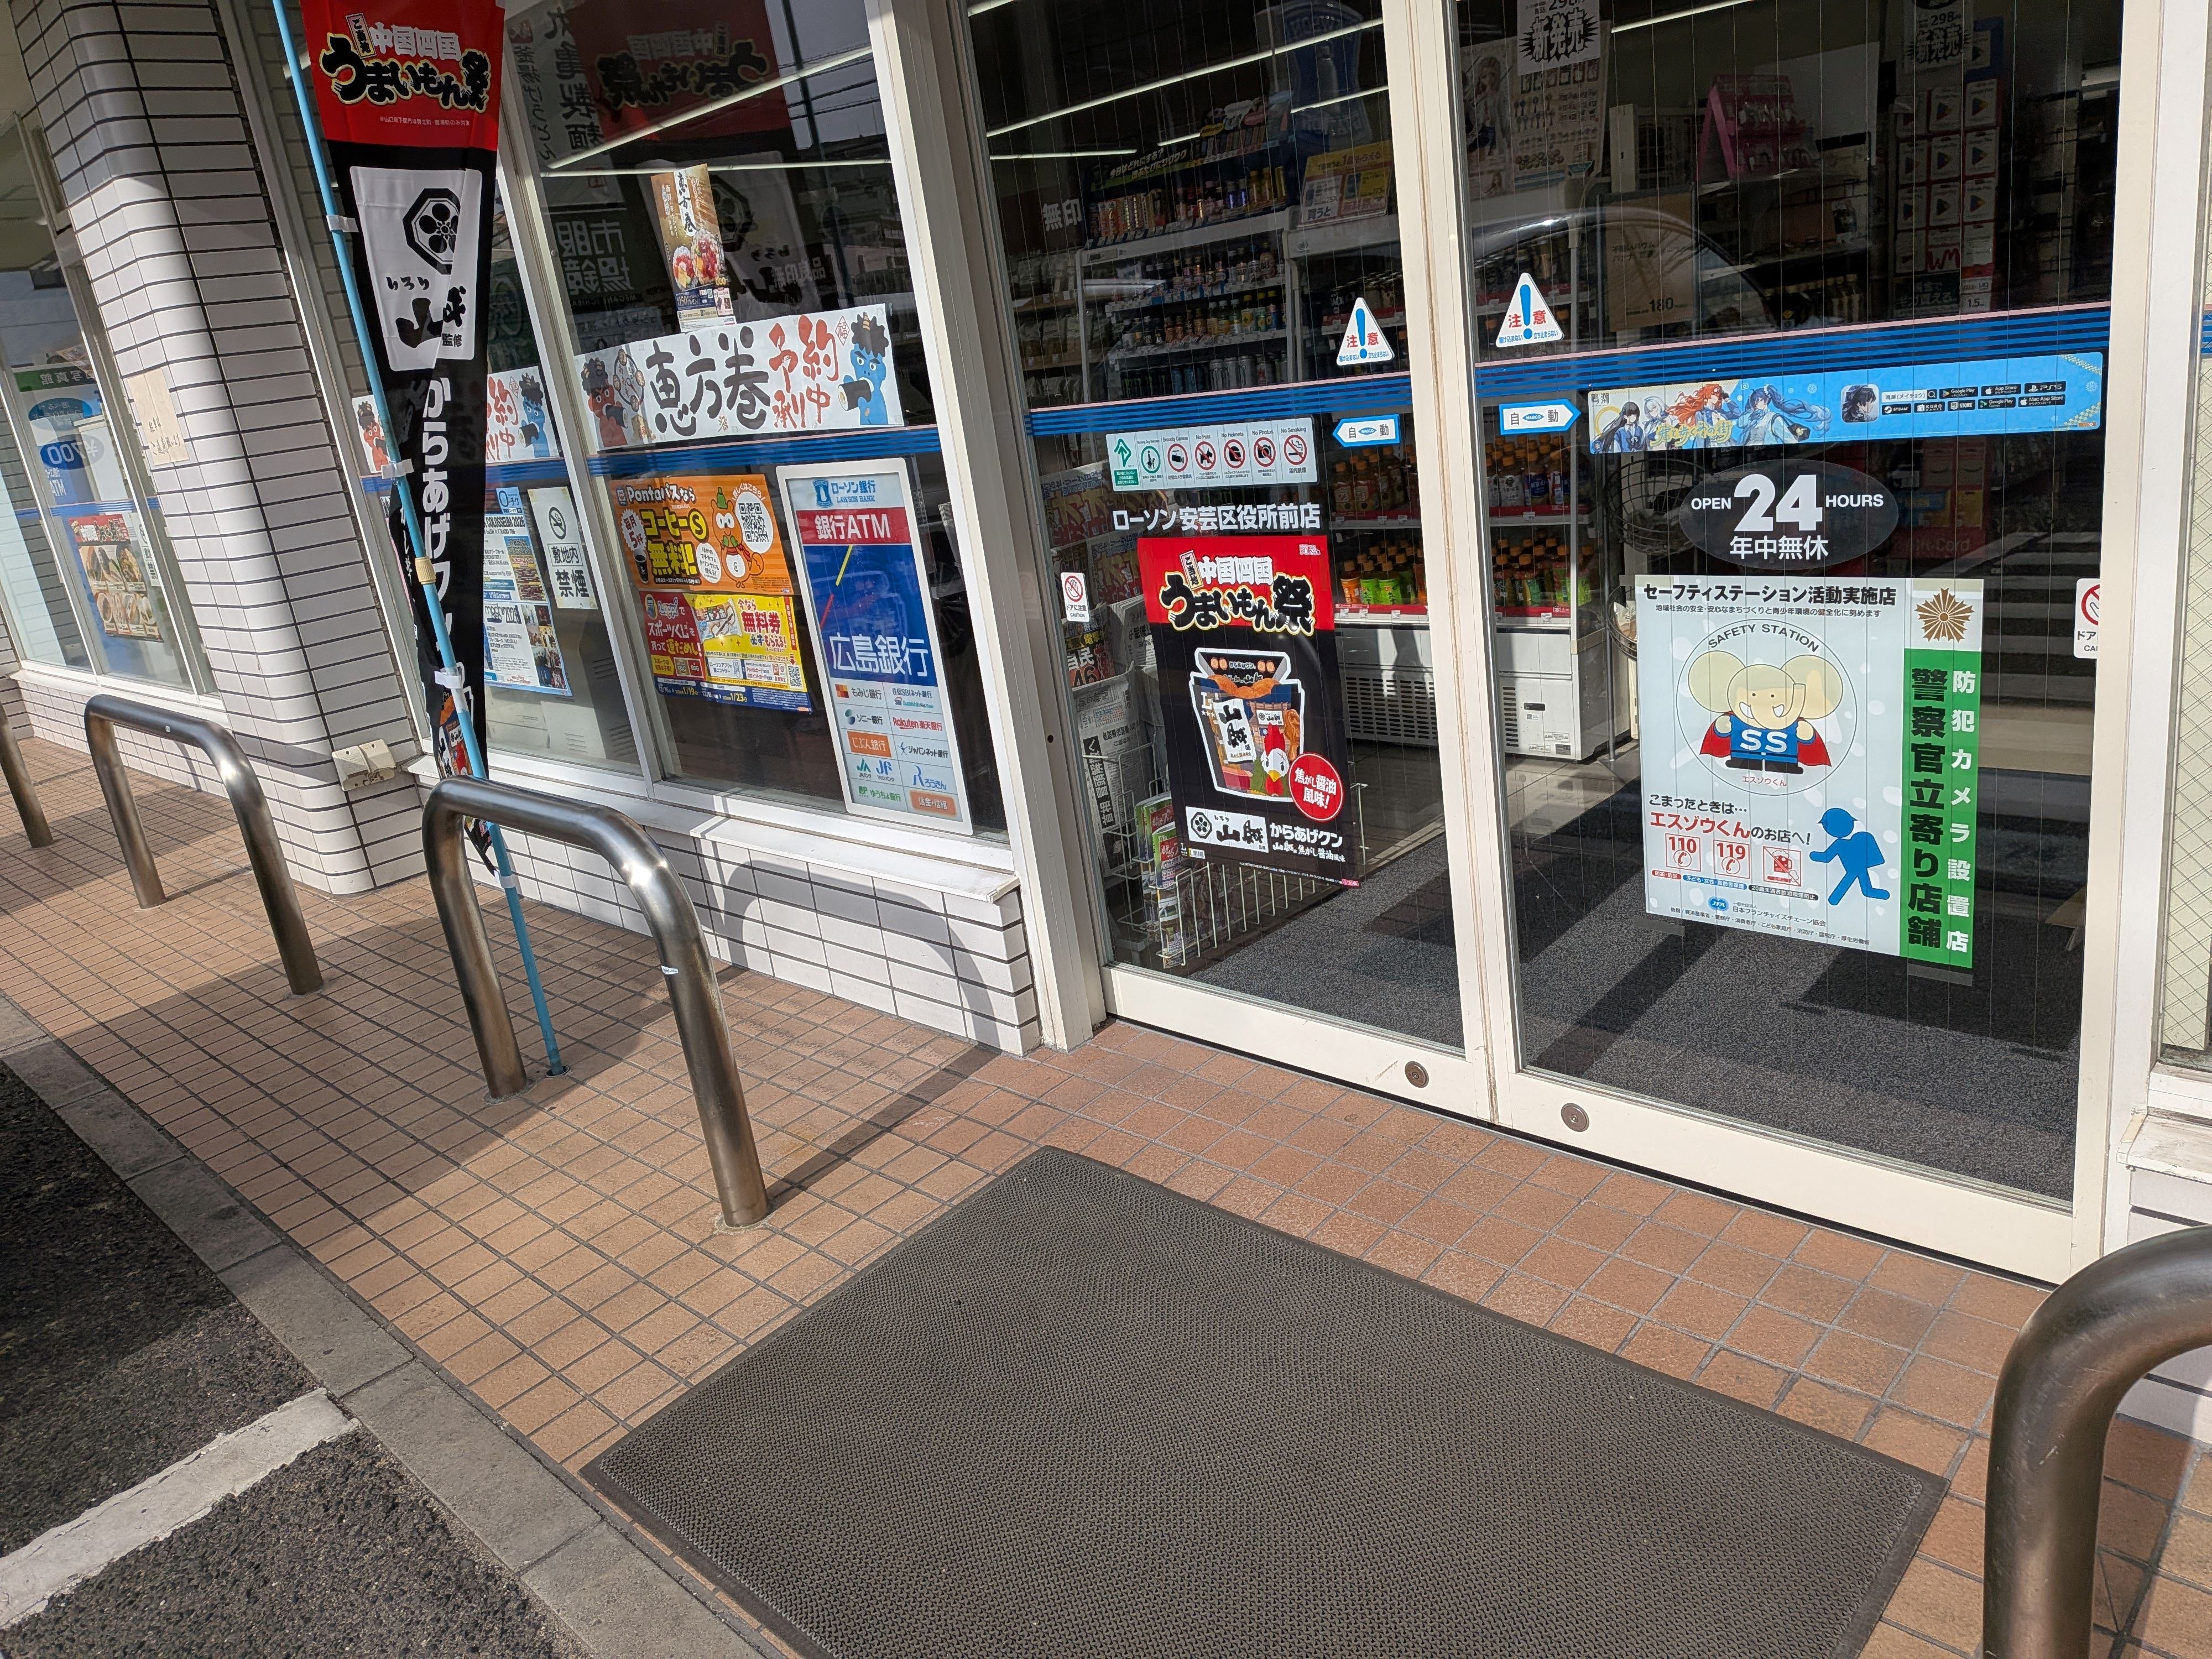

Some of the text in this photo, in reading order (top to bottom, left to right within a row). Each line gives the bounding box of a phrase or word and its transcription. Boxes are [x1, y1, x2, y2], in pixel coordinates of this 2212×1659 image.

[369, 22, 461, 60] 中国四国
[1531, 7, 1585, 62] 新発売
[768, 315, 839, 392] 予約
[831, 479, 876, 494] ローソン銀行
[836, 494, 876, 504] LAWSON BANK
[1691, 473, 1884, 531] OPEN 24 HOURS
[815, 513, 891, 540] 銀行ATM
[1113, 502, 1320, 531] ローソン安芸区役所前店
[551, 546, 581, 565] 敷地内
[1729, 535, 1829, 560] 年中無休
[1197, 556, 1273, 586] 中国四国
[555, 569, 590, 598] 禁煙
[1644, 583, 1897, 606] セーフティステーション活動実施店
[738, 598, 757, 611] 今なら
[1160, 571, 1316, 637] うまいもん祭
[742, 611, 781, 634] 無料券
[1709, 623, 1820, 653] SAFETY STATION
[829, 632, 929, 677] 広島銀行
[851, 687, 882, 700] もみじ銀行
[892, 687, 932, 699] 住信SBIネット銀行
[857, 713, 883, 726] ソニー銀行
[893, 717, 943, 732] Rakuten 楽天銀行
[852, 737, 886, 752] じぶん銀行
[908, 745, 948, 759] ジャパンネット銀行
[1739, 728, 1788, 754] SS
[924, 778, 947, 790] ろうきん
[1295, 768, 1337, 795] 焦がし醤油
[1741, 775, 1787, 787] エスゾウくん
[870, 789, 901, 802] ゆうちょ銀行
[1303, 787, 1330, 810] 風味!
[1907, 667, 1948, 950] 警察官立寄り店舗
[1945, 670, 1976, 953] 防犯カメラ設置店
[1270, 822, 1343, 848] からあげクン
[1650, 811, 1811, 846] エスゾウくんのお店へ!
[1668, 836, 1697, 852] 110
[1715, 842, 1746, 860] 119
[1733, 906, 1827, 927] 日本フランチャイズチェーン協会
